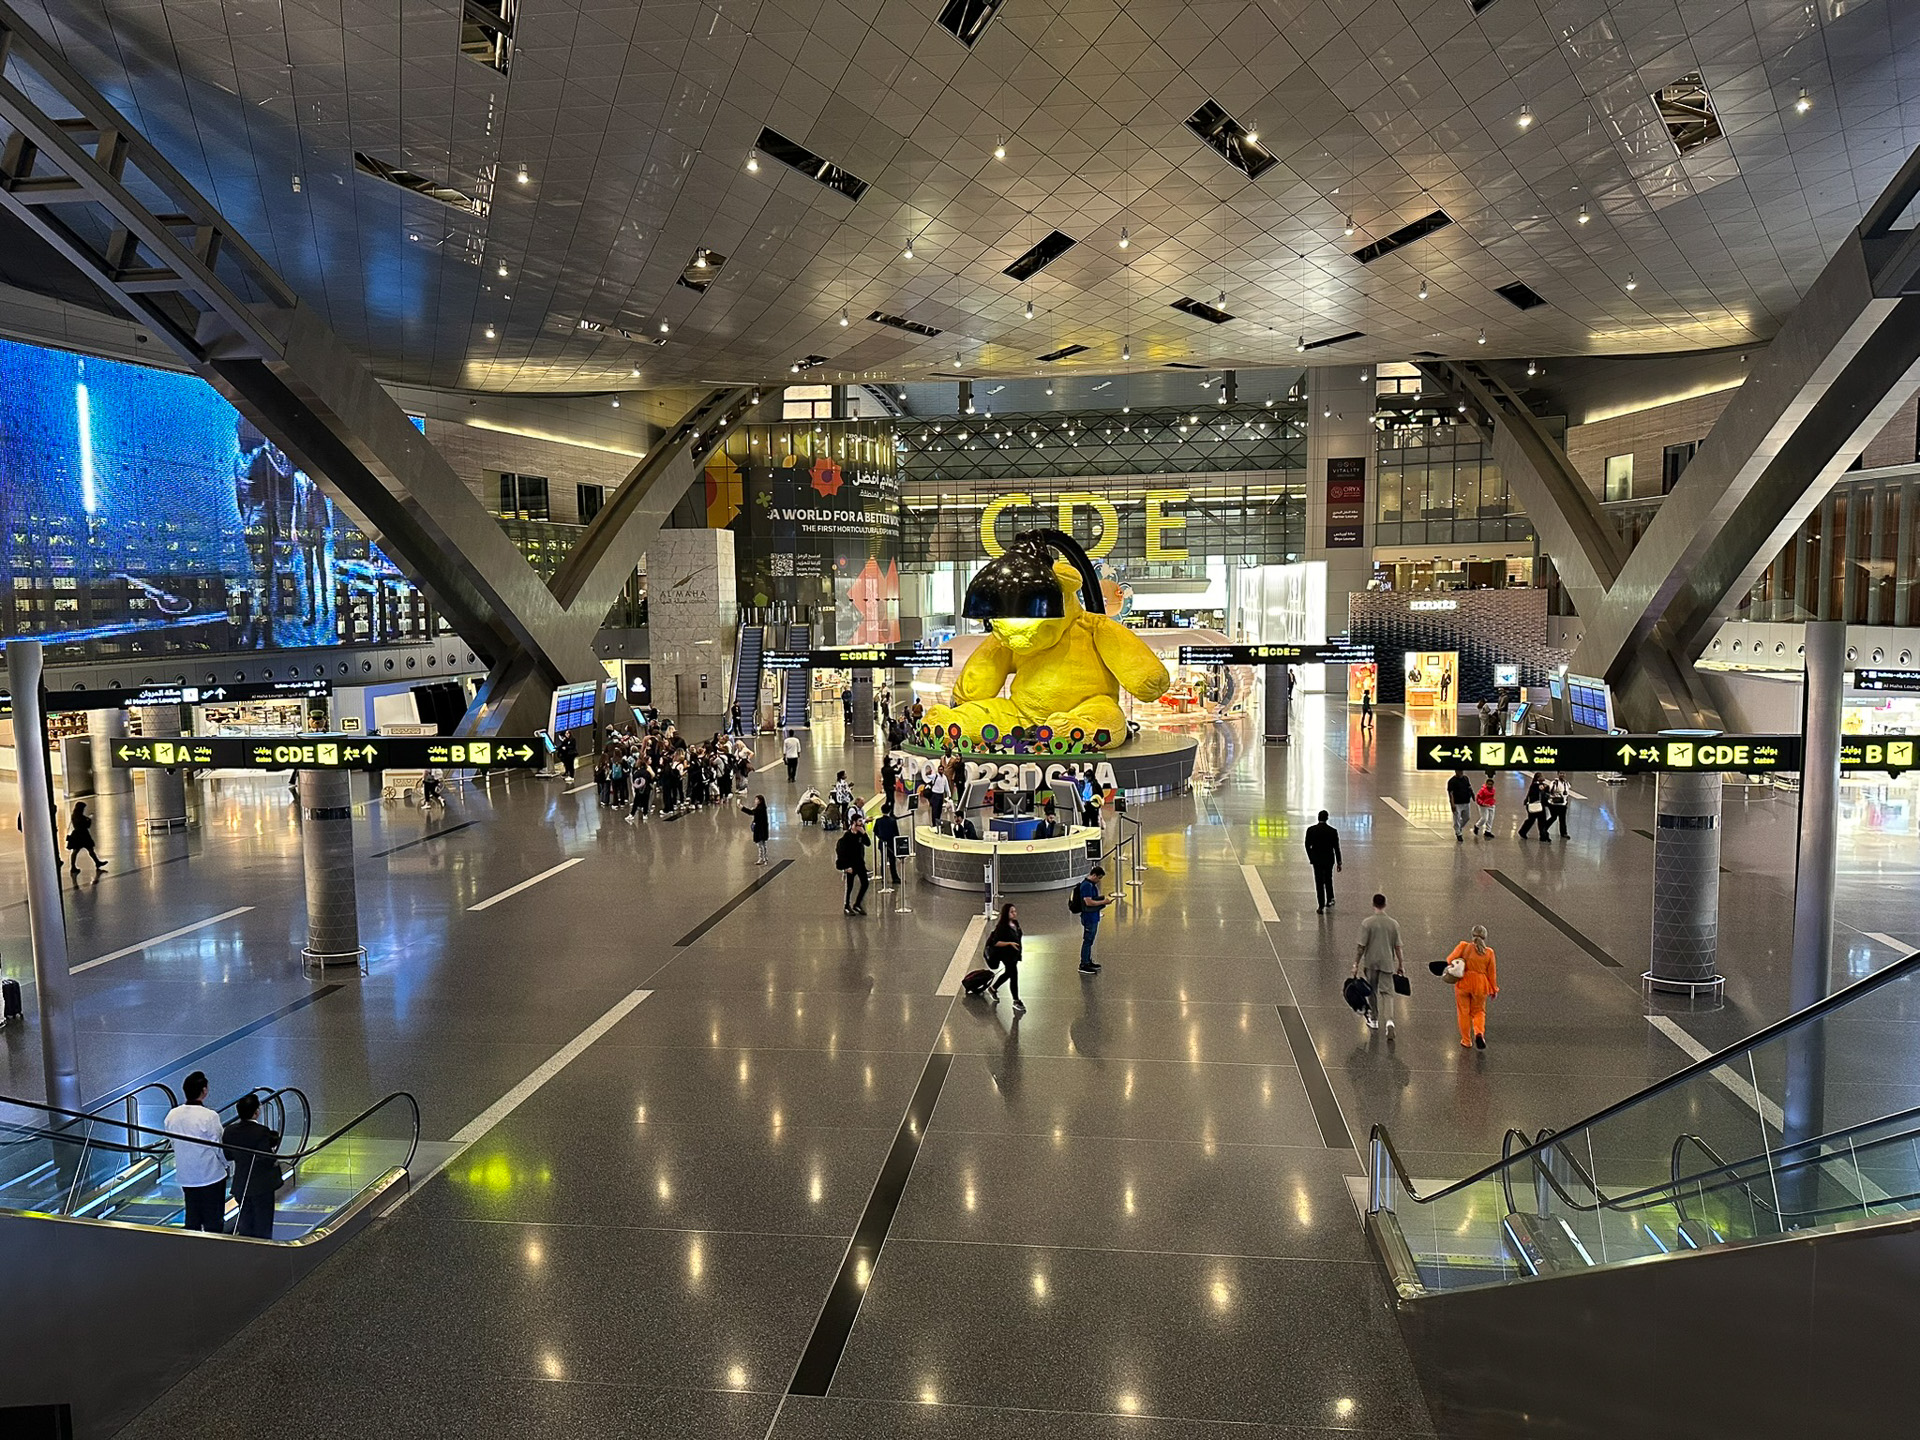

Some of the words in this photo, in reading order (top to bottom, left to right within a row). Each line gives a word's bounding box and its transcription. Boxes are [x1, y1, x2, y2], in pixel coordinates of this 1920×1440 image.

[782, 509, 832, 521] WORLD
[834, 510, 856, 521] FOR
[857, 511, 864, 522] A
[864, 512, 889, 525] BETTER
[802, 524, 816, 532] THE
[817, 525, 836, 533] FIRST
[676, 590, 706, 598] MAHA
[849, 652, 868, 660] CDE
[1269, 649, 1290, 657] CDE
[177, 745, 191, 762] A
[275, 746, 315, 763] CDE
[451, 745, 466, 762] B
[1509, 745, 1529, 764] A
[1697, 745, 1749, 764] CDE
[1865, 744, 1883, 764] B
